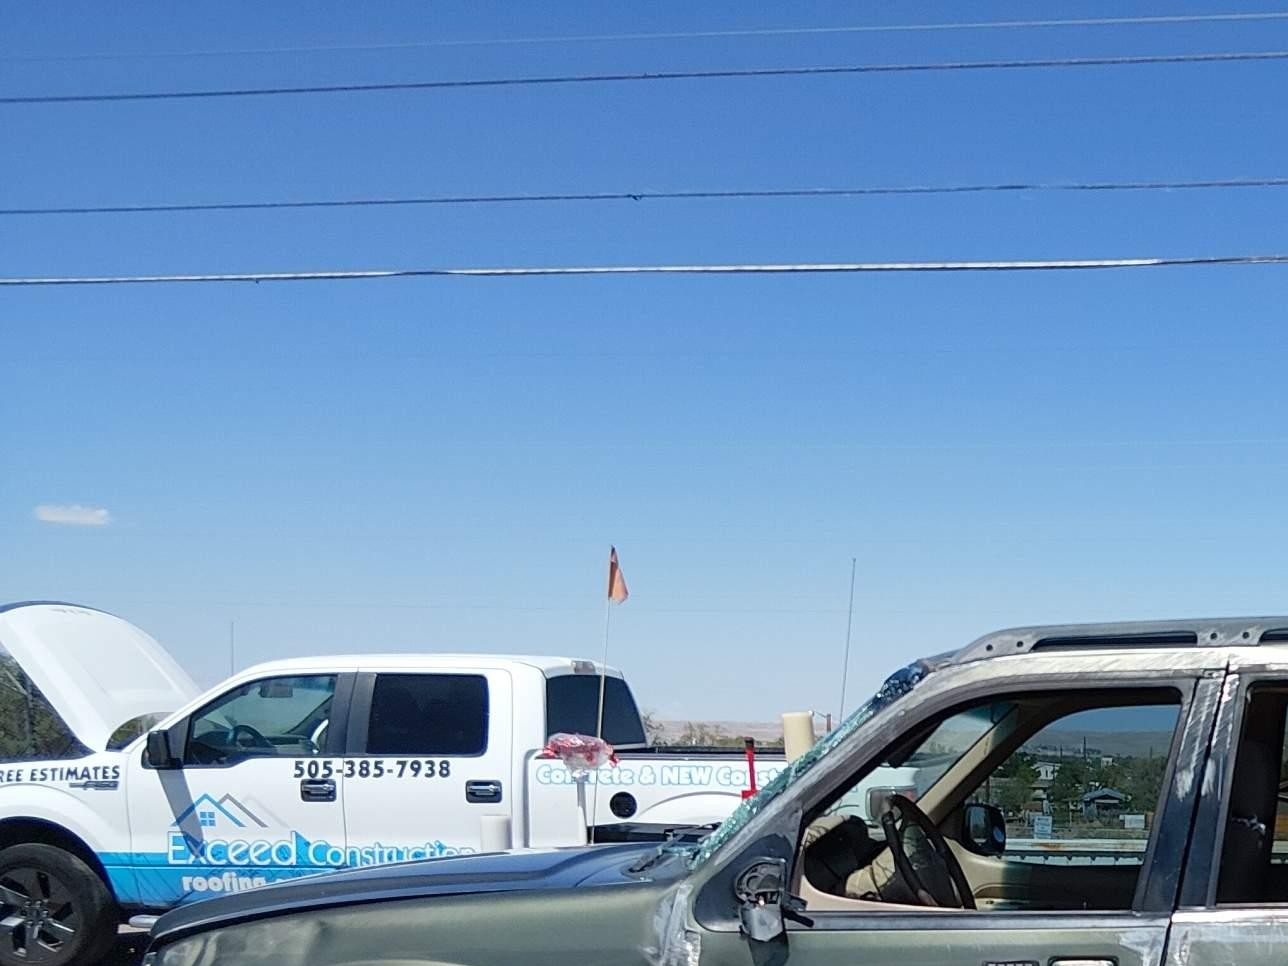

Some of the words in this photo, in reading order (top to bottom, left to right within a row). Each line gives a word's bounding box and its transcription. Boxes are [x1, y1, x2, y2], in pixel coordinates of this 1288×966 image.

[30, 765, 120, 782] ESTIMATES
[293, 760, 451, 779] 505-385-7938
[536, 764, 633, 786] Conrete
[638, 764, 657, 786] &
[661, 766, 713, 786] NEW
[168, 830, 297, 866] Exceed
